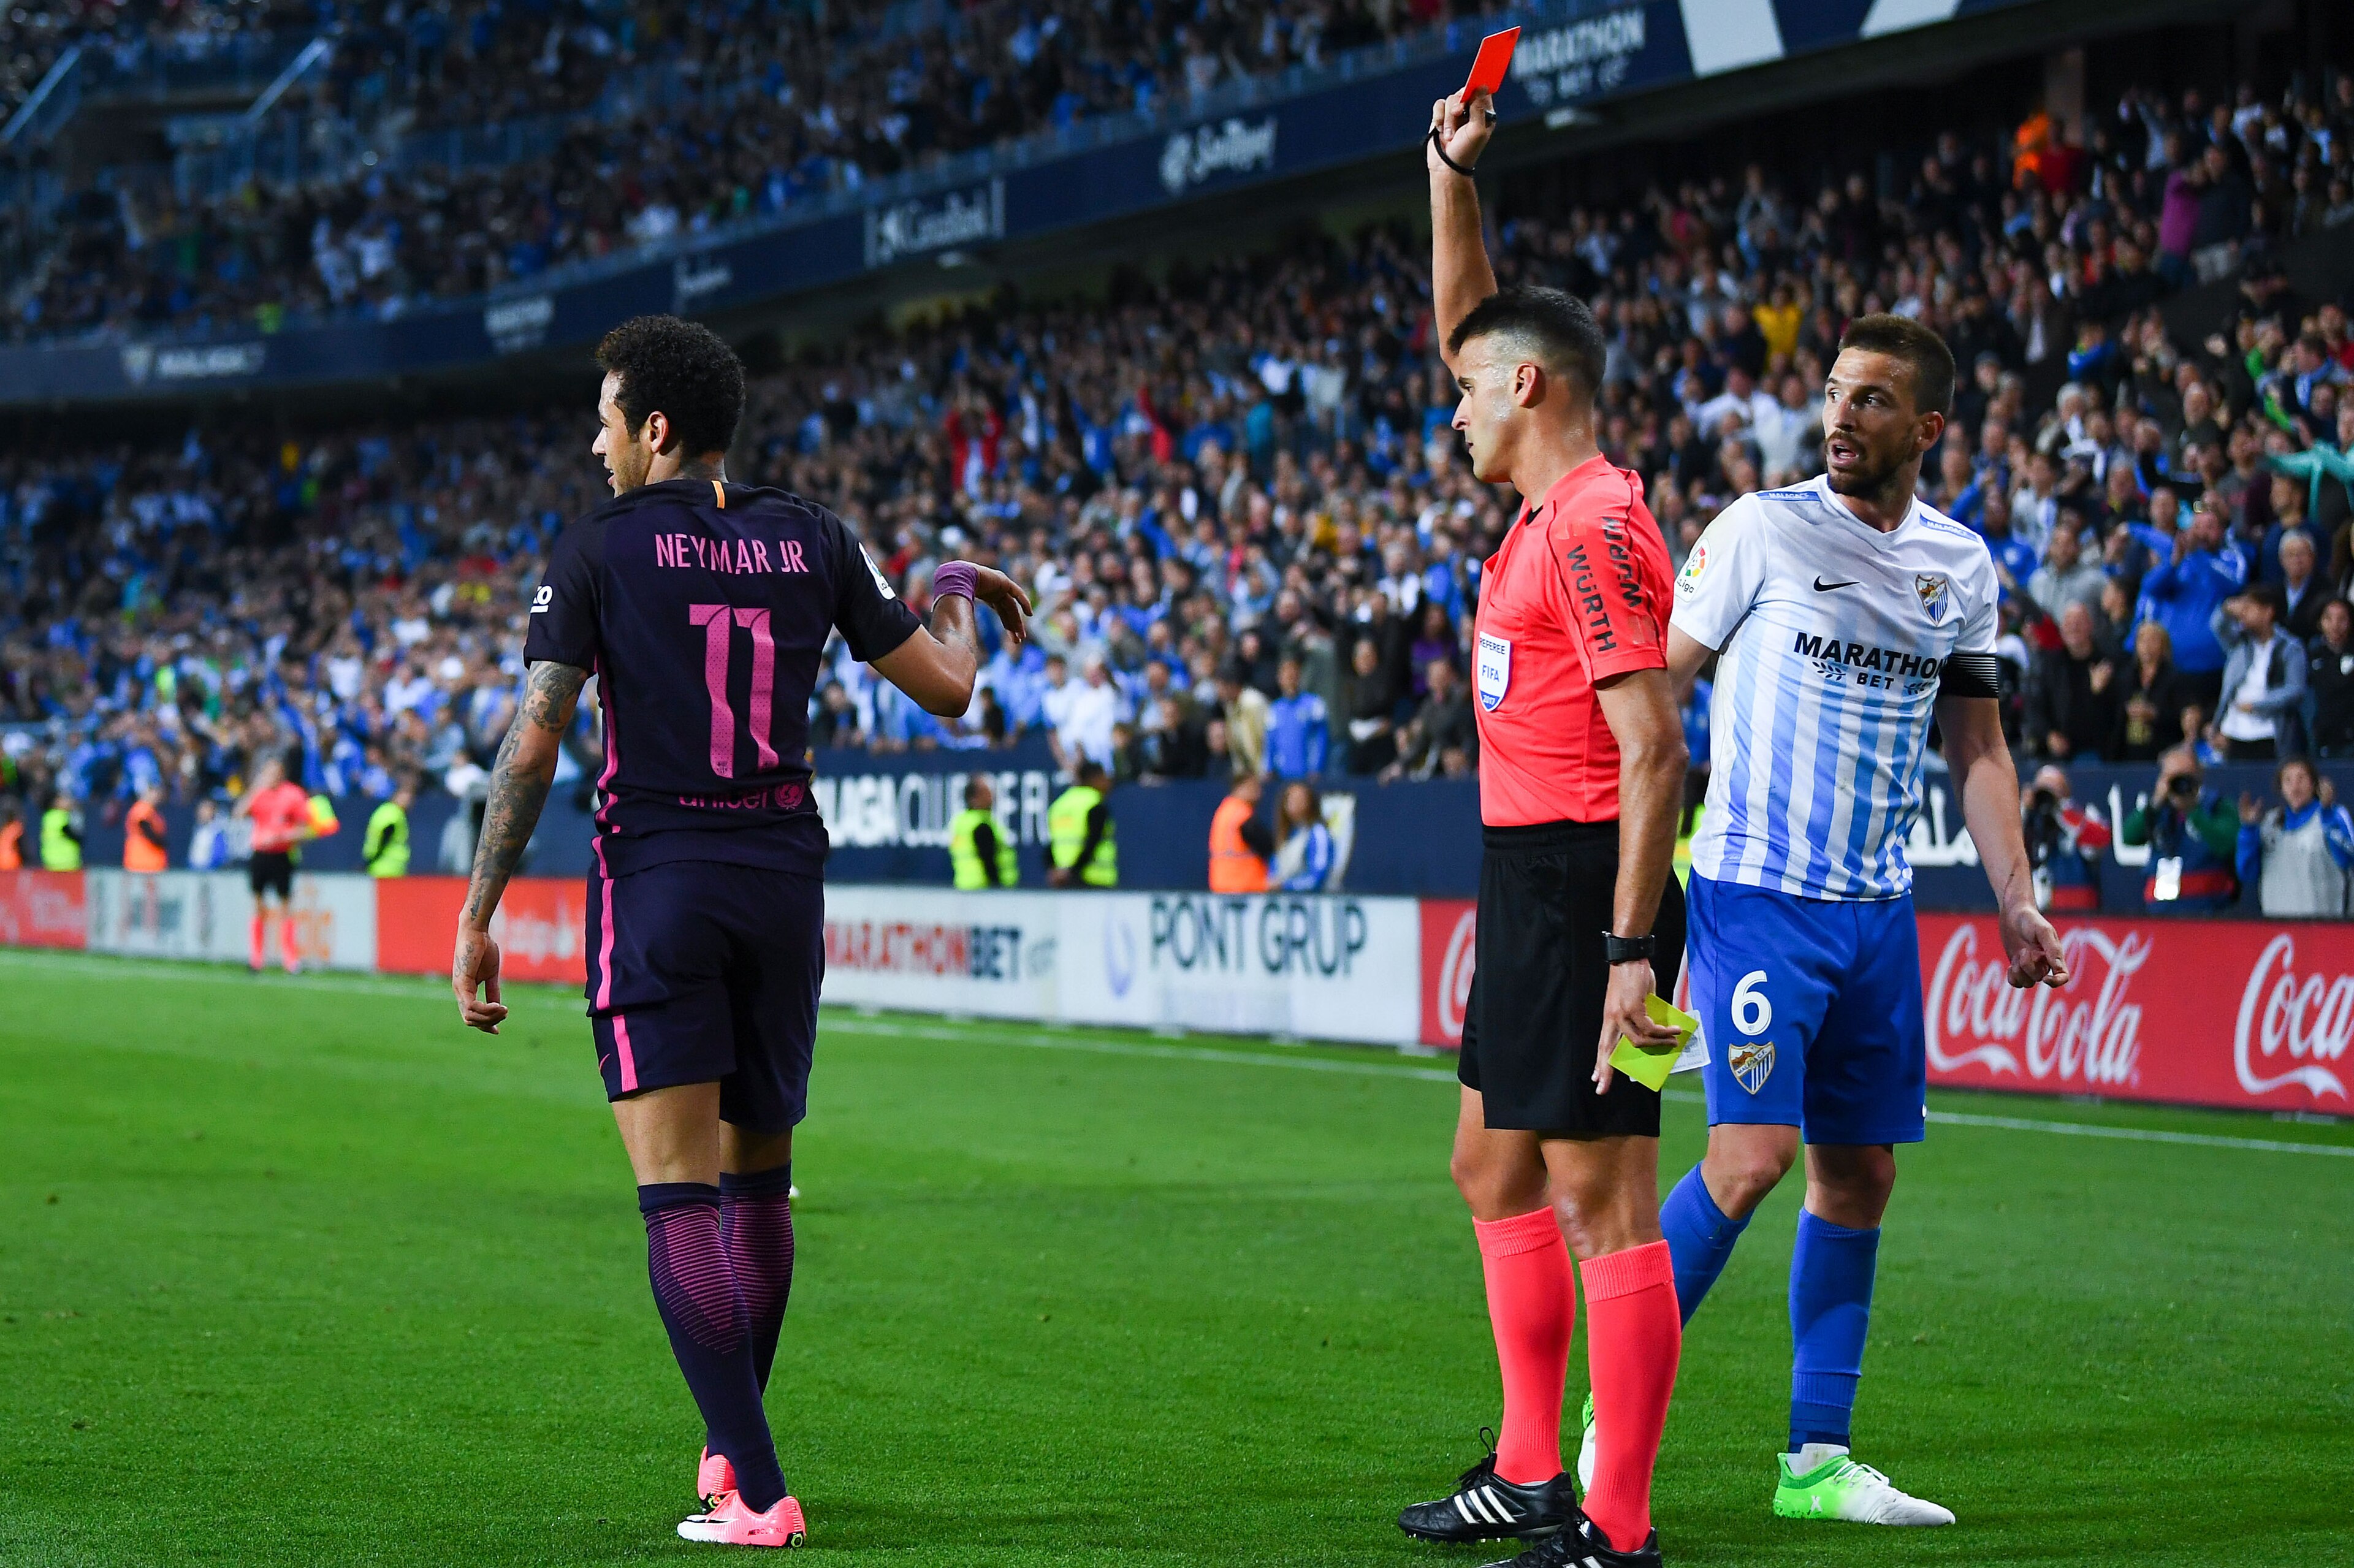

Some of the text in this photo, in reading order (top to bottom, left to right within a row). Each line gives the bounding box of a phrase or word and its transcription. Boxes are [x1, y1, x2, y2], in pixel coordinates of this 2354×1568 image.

[655, 533, 810, 574] NEYMAR JR
[689, 604, 779, 778] 11
[1482, 664, 1500, 682] FIFA
[1856, 672, 1895, 690] BET
[1149, 897, 1249, 972] PONT
[1257, 897, 1369, 980] GRUP
[1731, 970, 1772, 1036] 6
